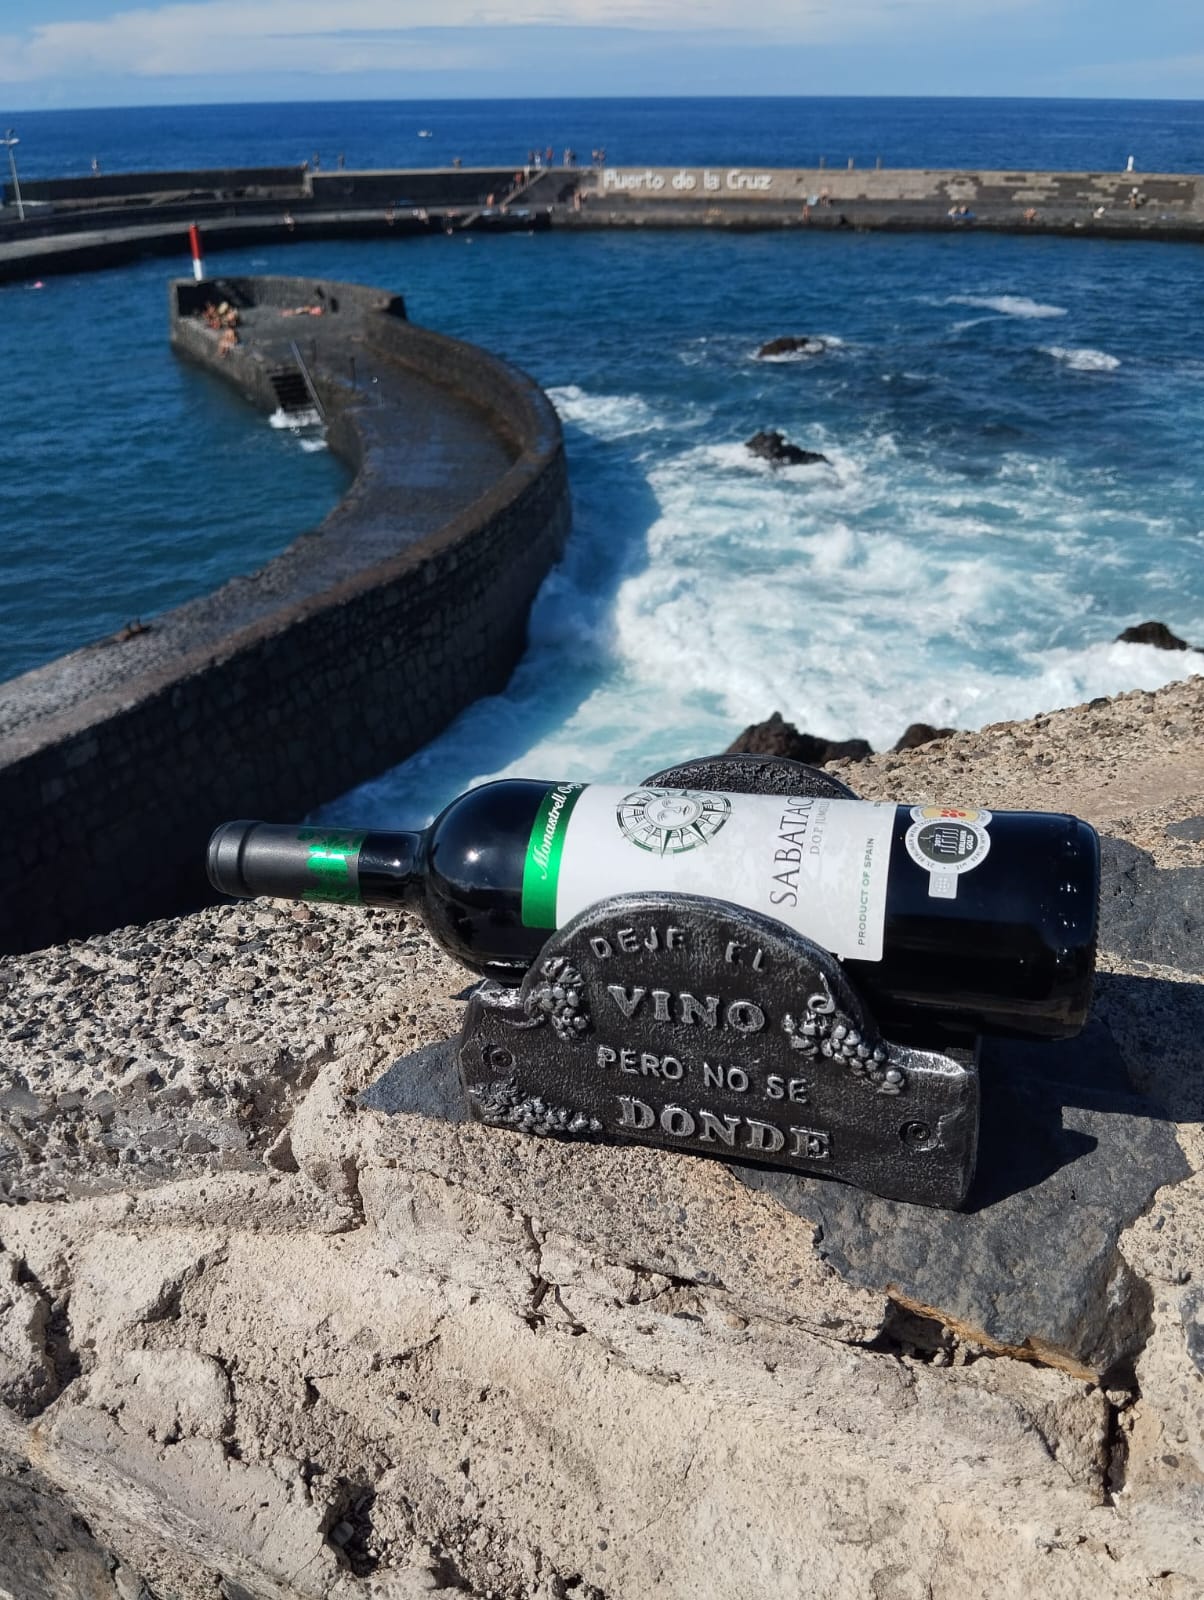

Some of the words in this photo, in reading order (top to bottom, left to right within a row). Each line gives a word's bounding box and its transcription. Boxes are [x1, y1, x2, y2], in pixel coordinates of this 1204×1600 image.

[603, 168, 665, 191] Puerto
[672, 168, 696, 190] de
[704, 168, 720, 191] la
[726, 168, 773, 190] Cruz
[532, 792, 567, 880] Monastrell
[863, 837, 875, 868] SPAIN
[966, 834, 974, 850] GOLD
[861, 870, 871, 887] OF
[857, 889, 869, 946] PRODUCT
[606, 984, 766, 1033] VINO
[597, 1046, 684, 1080] PERO
[703, 1061, 749, 1092] NO
[766, 1073, 808, 1103] SE
[616, 1095, 831, 1159] DONDE
